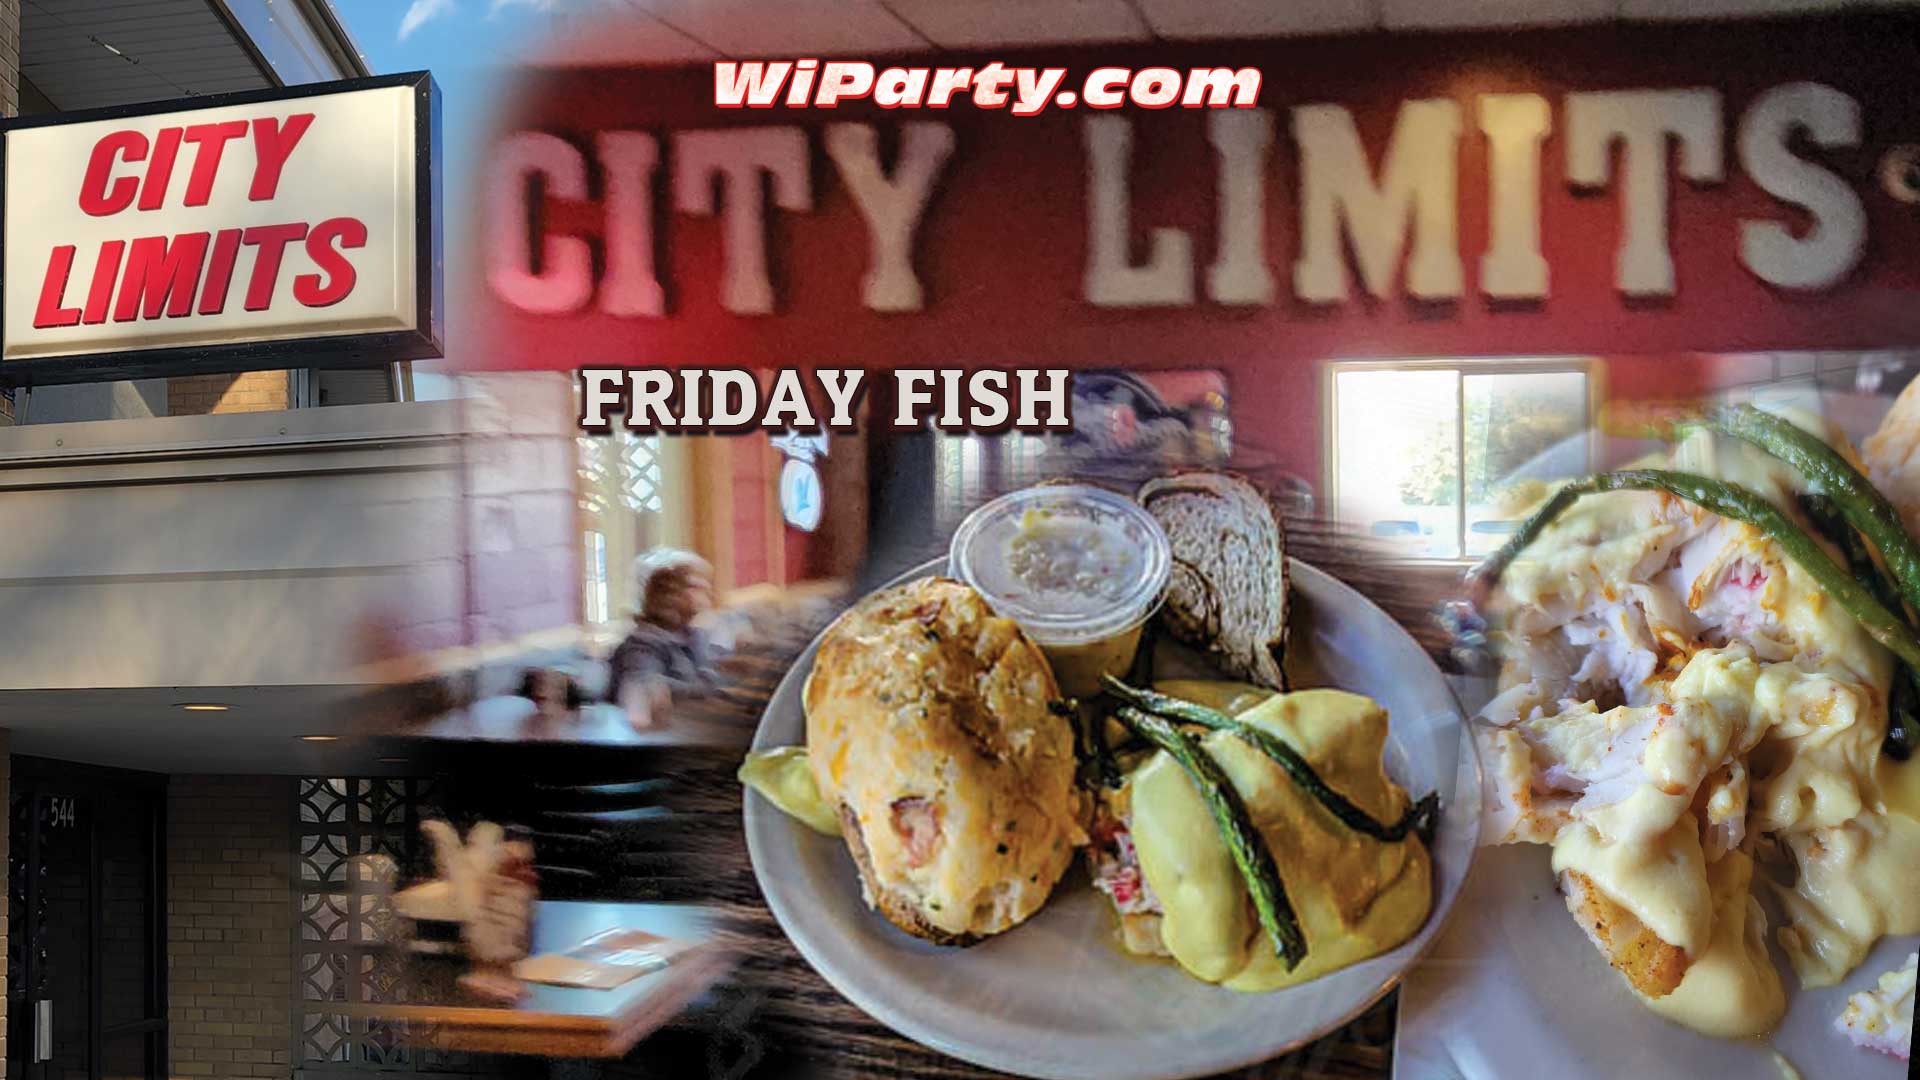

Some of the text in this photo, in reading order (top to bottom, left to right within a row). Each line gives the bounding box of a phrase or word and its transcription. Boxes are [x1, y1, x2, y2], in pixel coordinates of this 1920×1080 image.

[79, 113, 315, 216] CITY
[485, 83, 1868, 316] CITY LIMITS
[33, 217, 367, 328] LIMITS
[51, 797, 75, 828] 544
